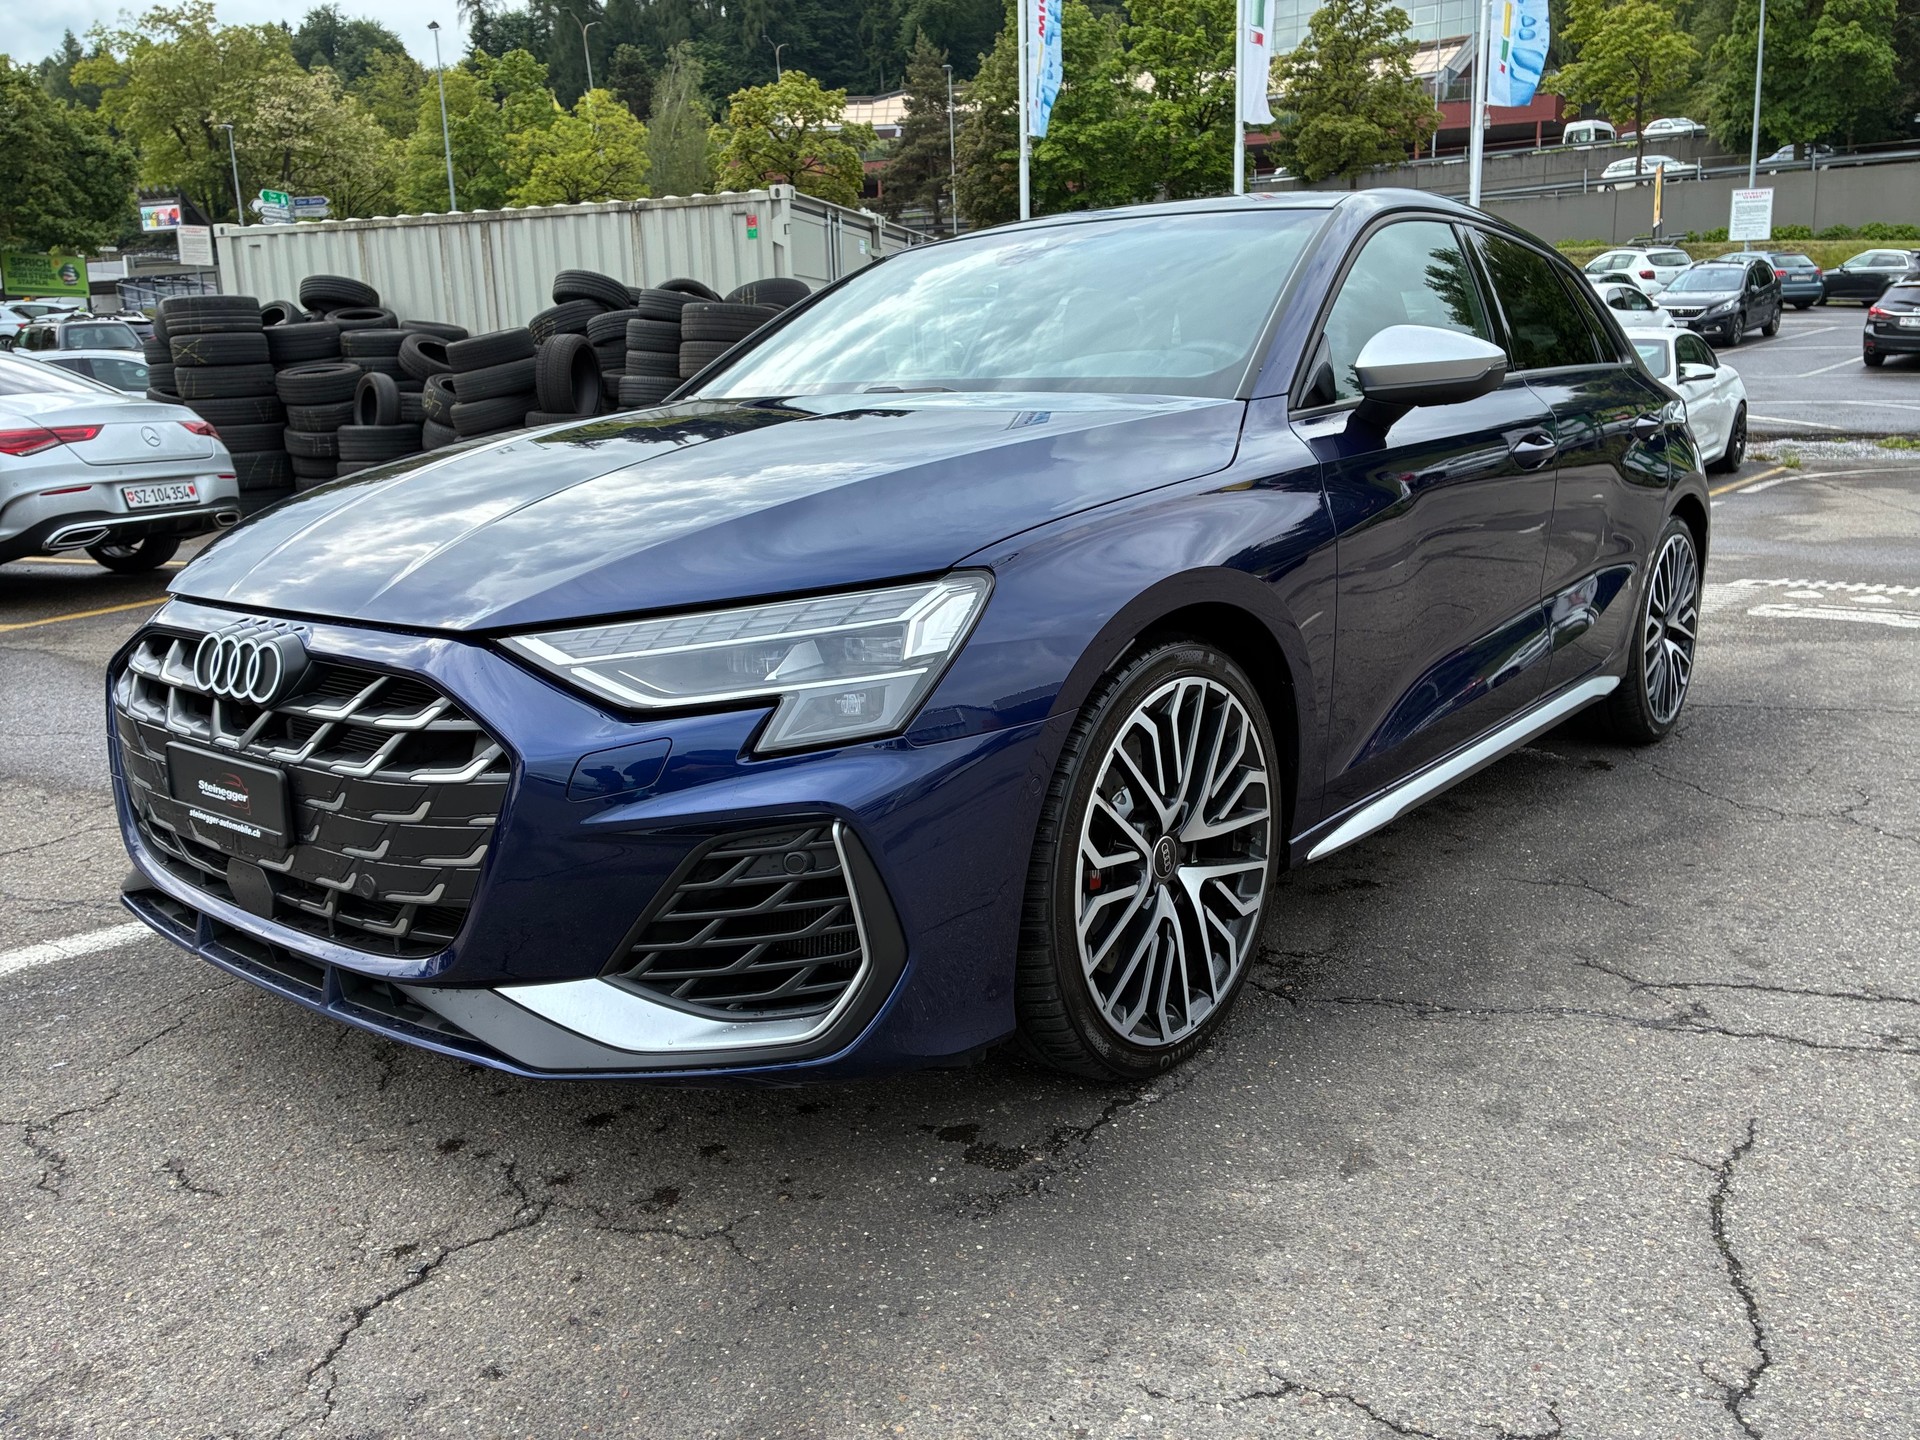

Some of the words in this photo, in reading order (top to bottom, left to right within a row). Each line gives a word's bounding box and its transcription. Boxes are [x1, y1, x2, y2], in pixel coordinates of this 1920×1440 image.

[10, 257, 51, 268] SPRICH
[198, 780, 248, 802] Steinegger
[189, 809, 261, 838] steinegger-automobile.ch
